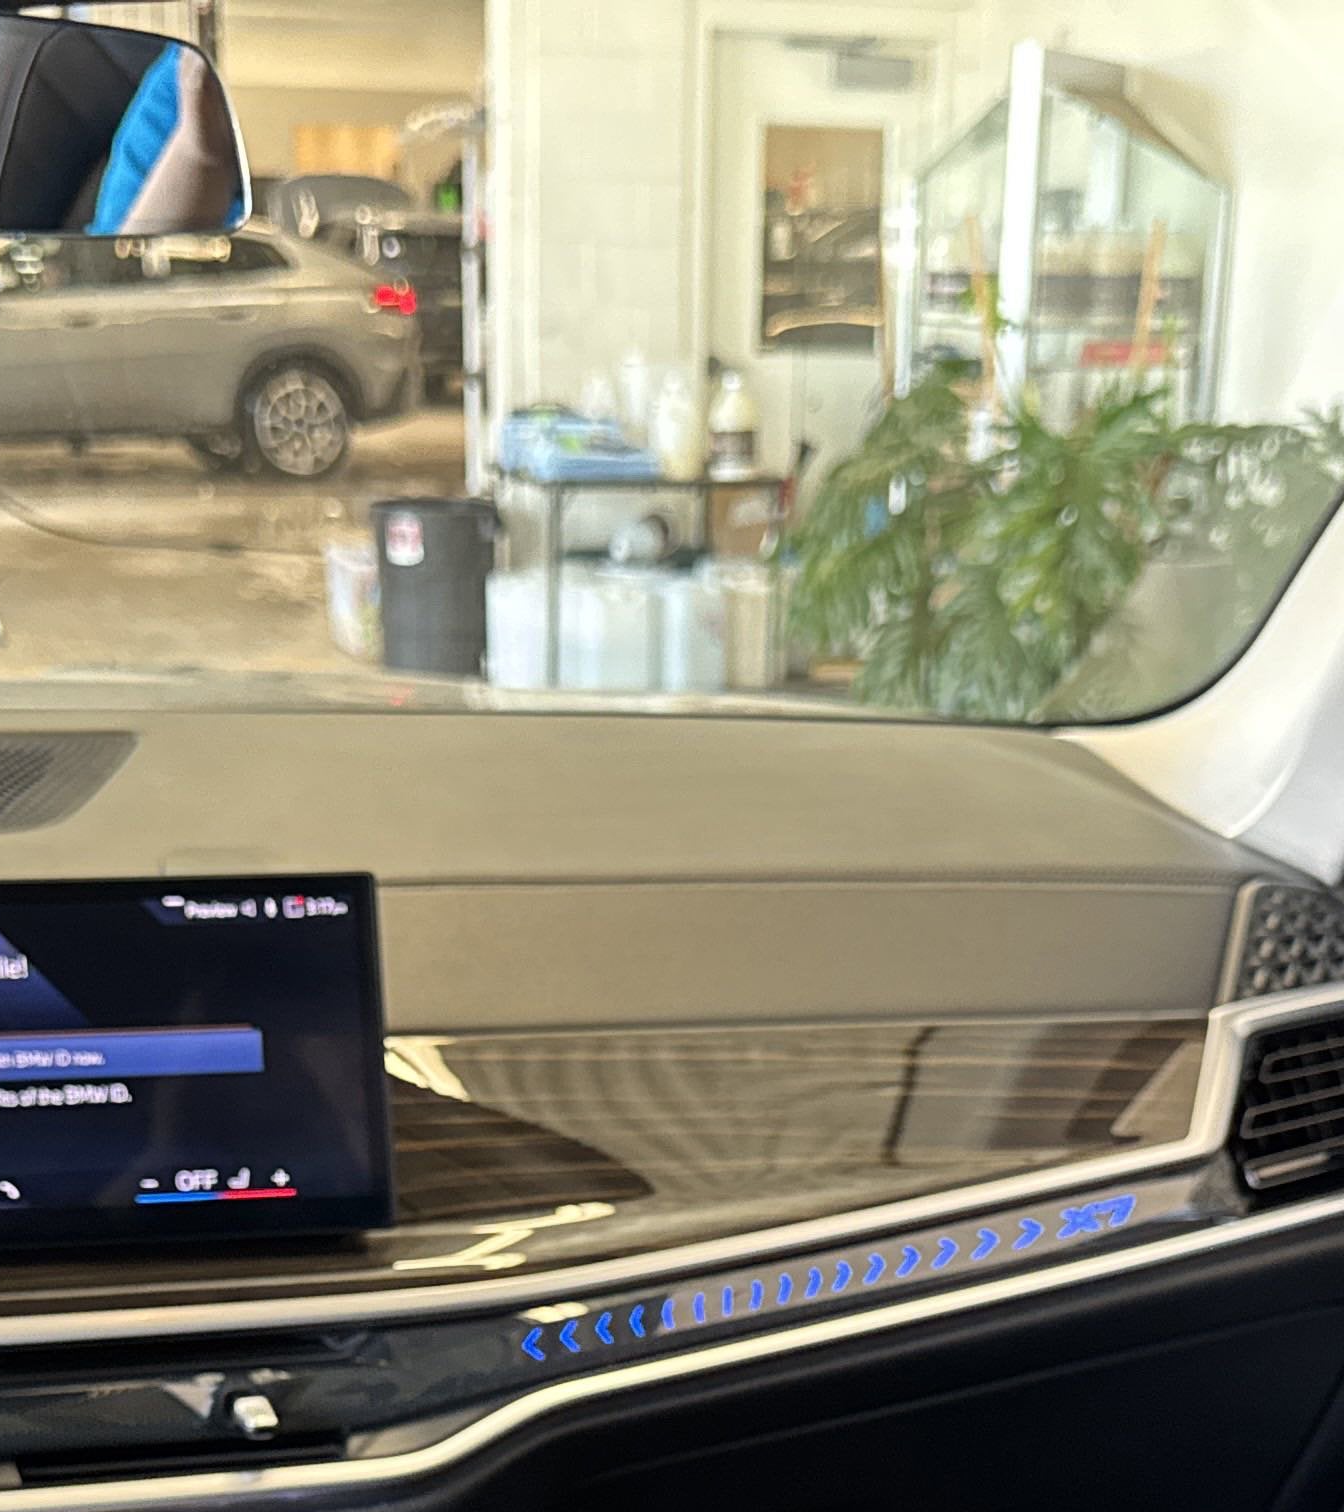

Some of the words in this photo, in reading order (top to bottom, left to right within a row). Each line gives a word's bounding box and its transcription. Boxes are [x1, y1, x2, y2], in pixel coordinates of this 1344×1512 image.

[15, 1050, 54, 1068] BMW
[175, 1168, 218, 1192] OFF
[1056, 1194, 1136, 1239] X7
